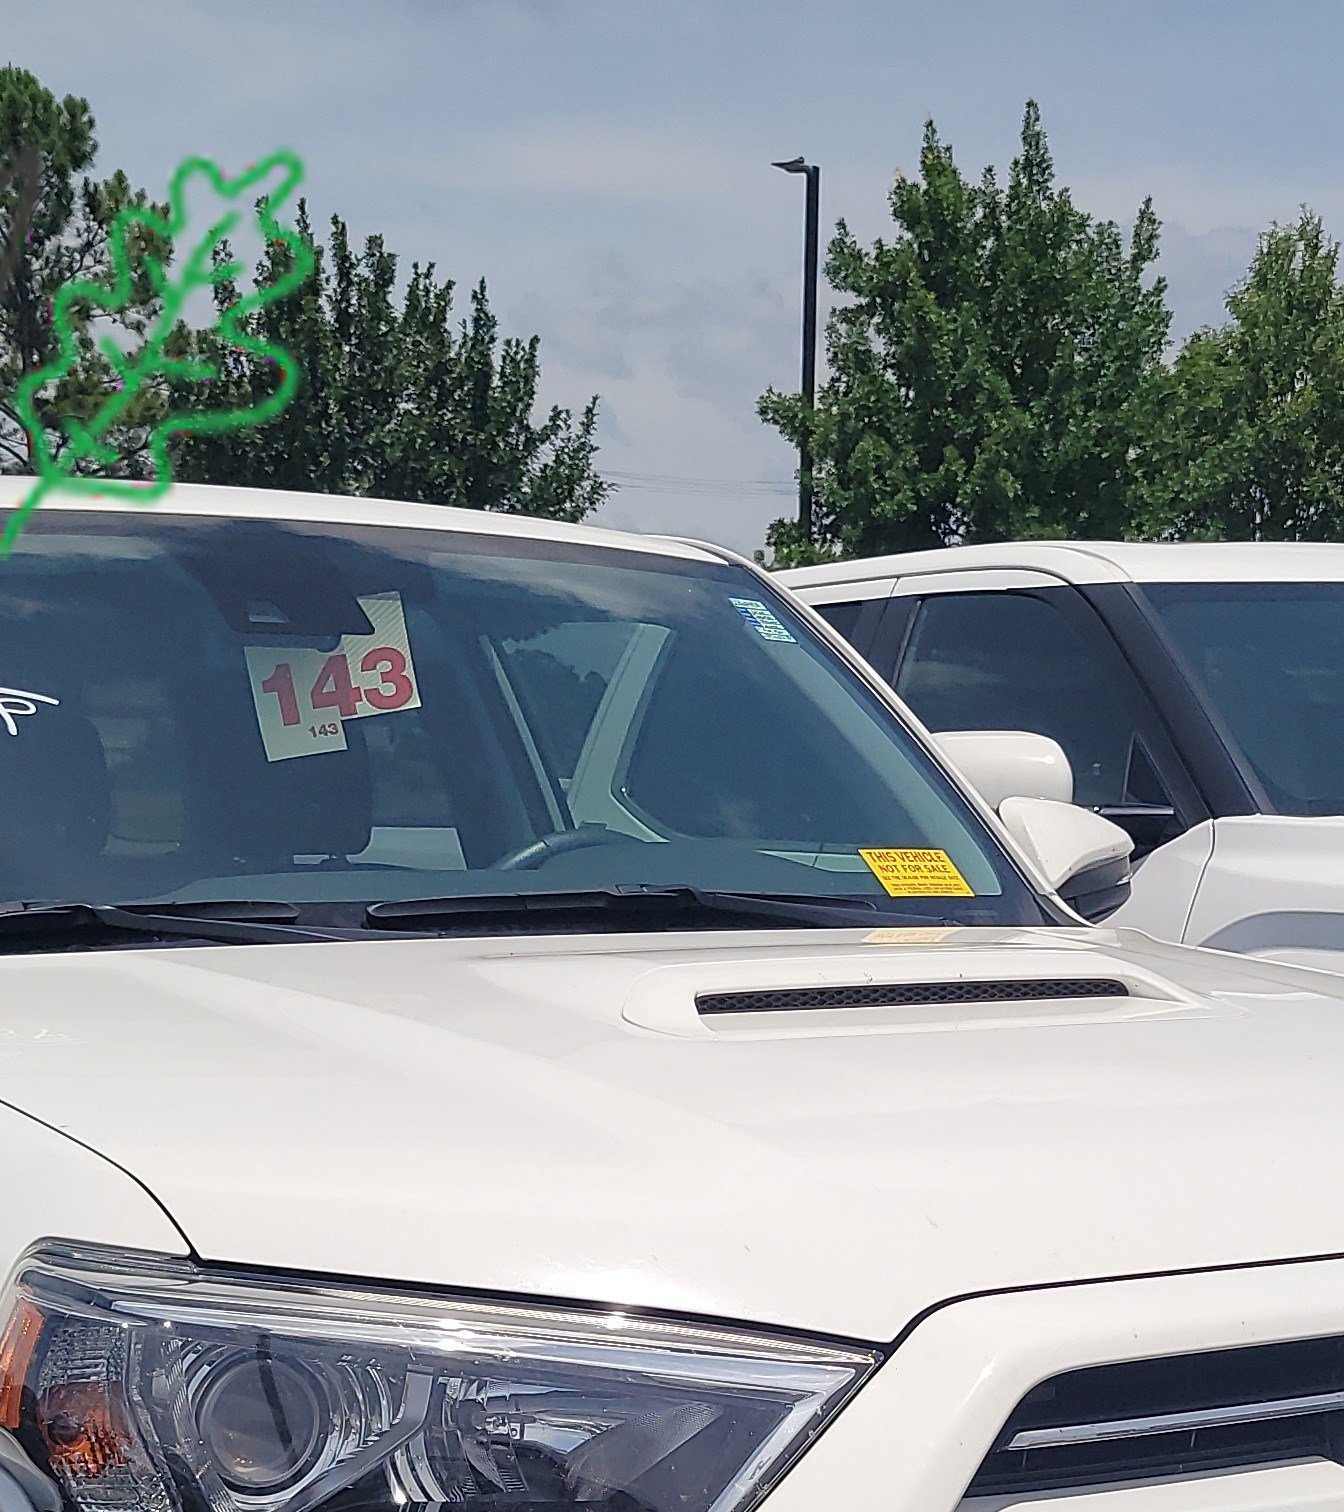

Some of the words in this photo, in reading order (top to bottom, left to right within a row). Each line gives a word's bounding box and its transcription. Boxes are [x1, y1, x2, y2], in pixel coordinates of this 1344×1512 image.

[261, 646, 414, 727] 143
[308, 722, 340, 739] 143
[865, 851, 897, 863] THIS
[894, 851, 946, 863] VEHICLE
[877, 864, 900, 874] NOT
[900, 864, 924, 874] FOR
[923, 864, 951, 874] SALE
